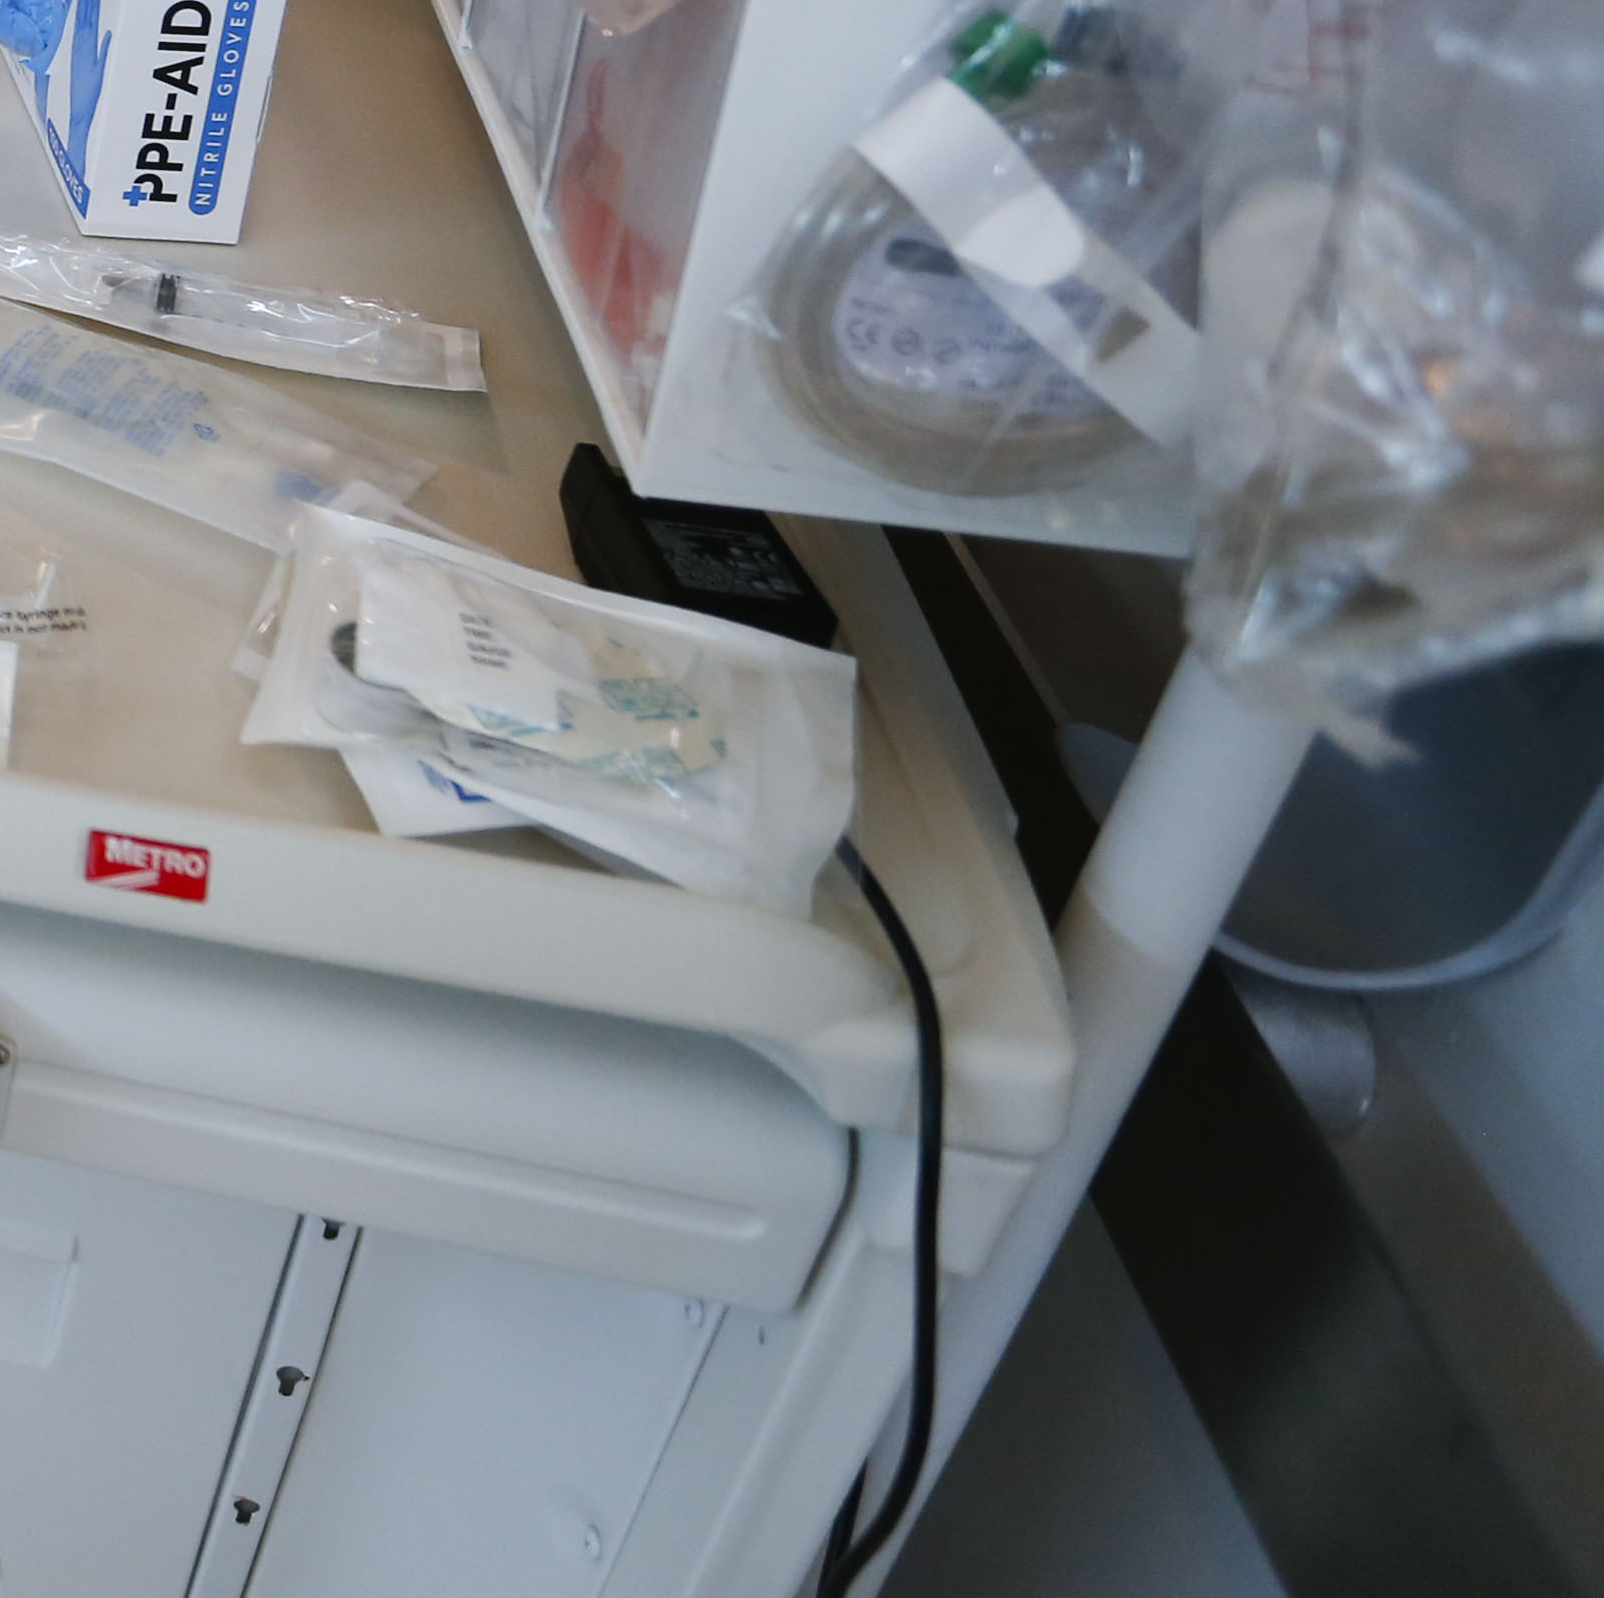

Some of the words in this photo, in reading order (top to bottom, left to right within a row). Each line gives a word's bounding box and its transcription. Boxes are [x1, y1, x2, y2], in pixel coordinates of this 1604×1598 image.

[133, 0, 212, 203] PPE-AID
[195, 112, 228, 206] NITRILE
[217, 0, 250, 96] GLOVES
[105, 835, 207, 879] METRO
